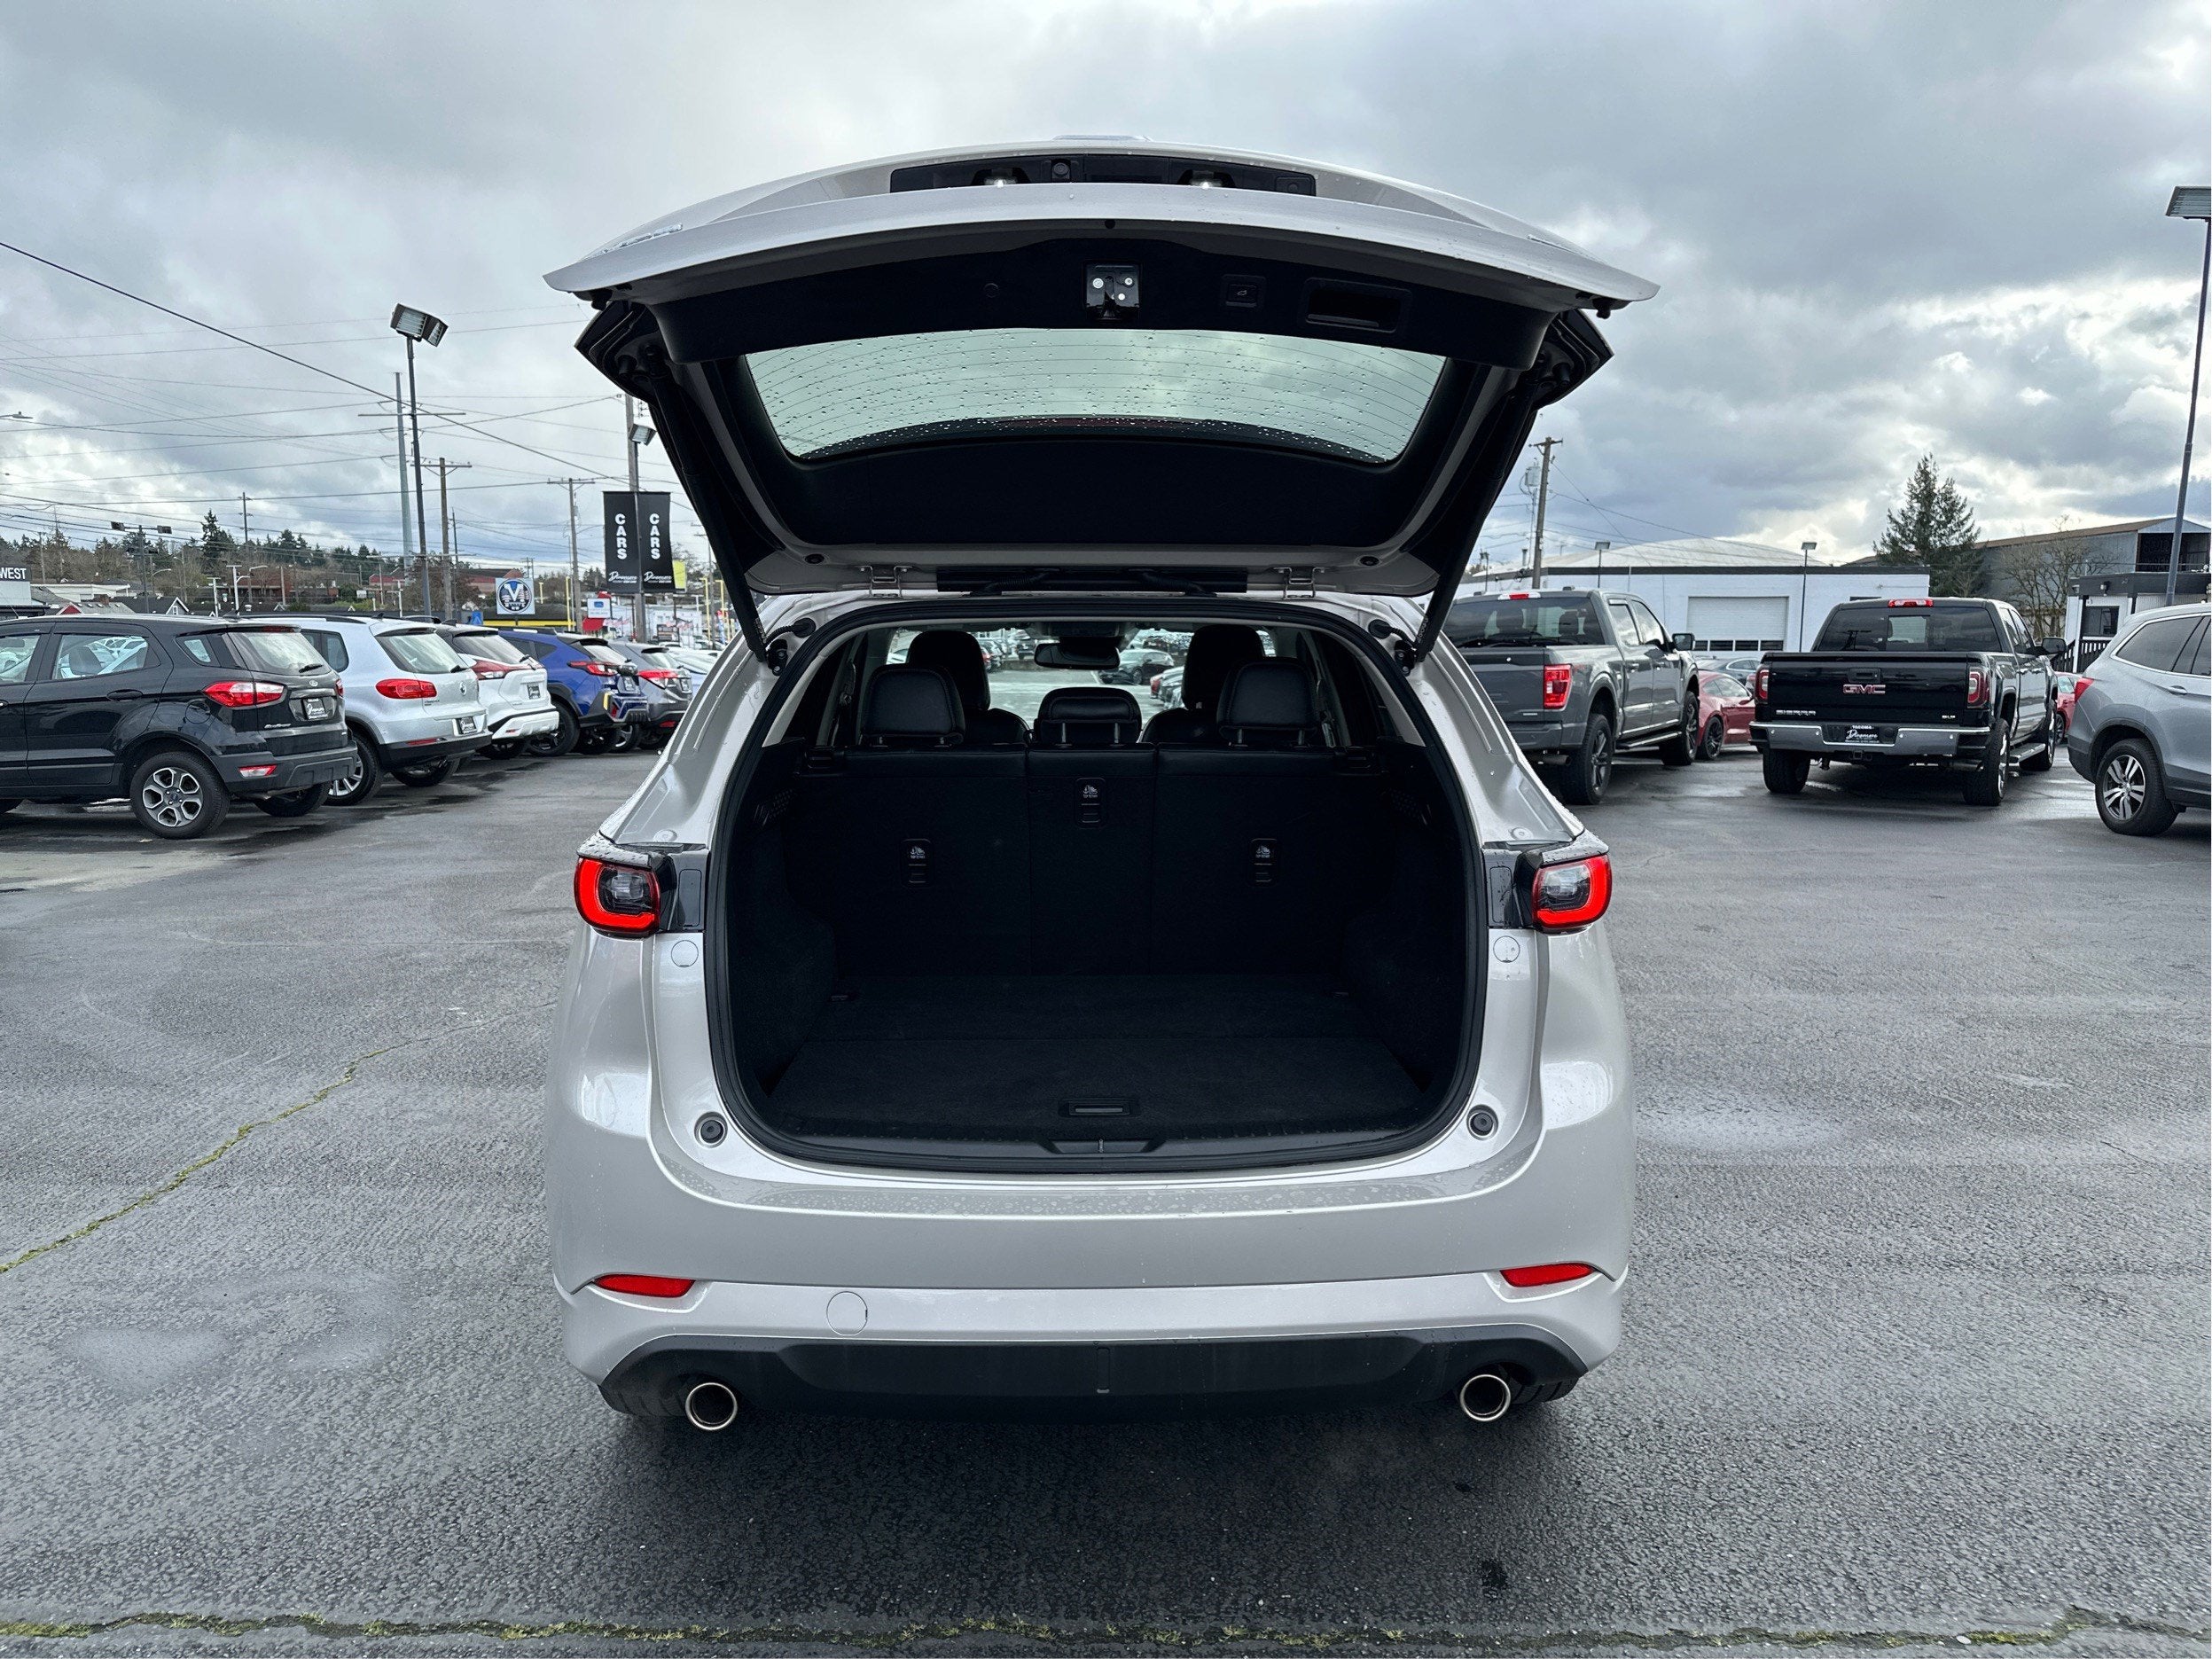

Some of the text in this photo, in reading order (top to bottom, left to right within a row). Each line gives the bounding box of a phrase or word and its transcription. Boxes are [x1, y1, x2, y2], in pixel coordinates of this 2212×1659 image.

[614, 513, 628, 560] CARS
[649, 513, 660, 560] CARS
[1843, 684, 1886, 694] GMC
